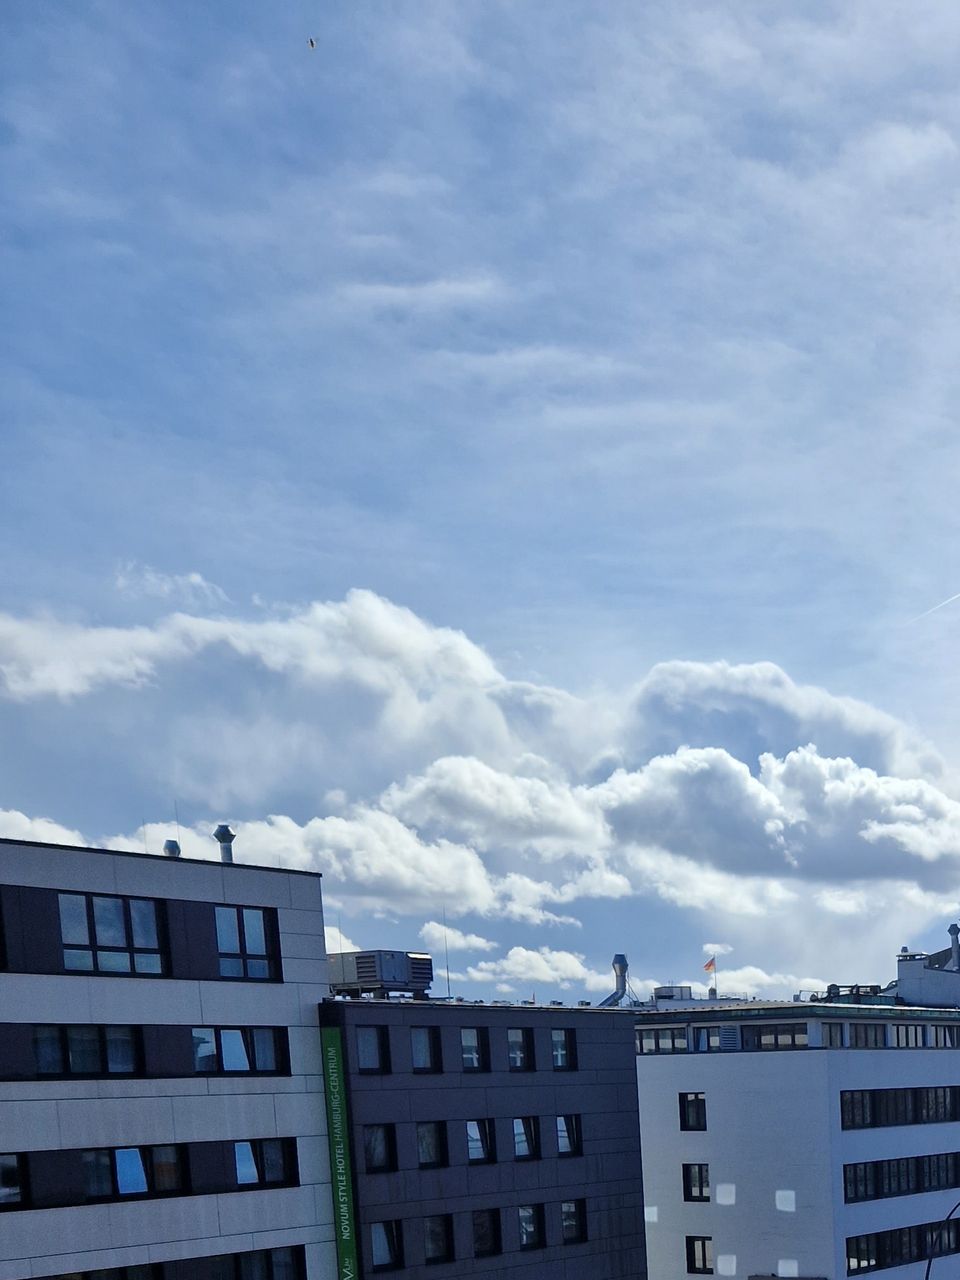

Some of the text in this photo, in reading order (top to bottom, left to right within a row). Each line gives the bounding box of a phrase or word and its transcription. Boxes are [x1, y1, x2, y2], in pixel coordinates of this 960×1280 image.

[328, 1047, 351, 1240] NOVUM STYLE HOTEL HAMBURG-CENTRUM
